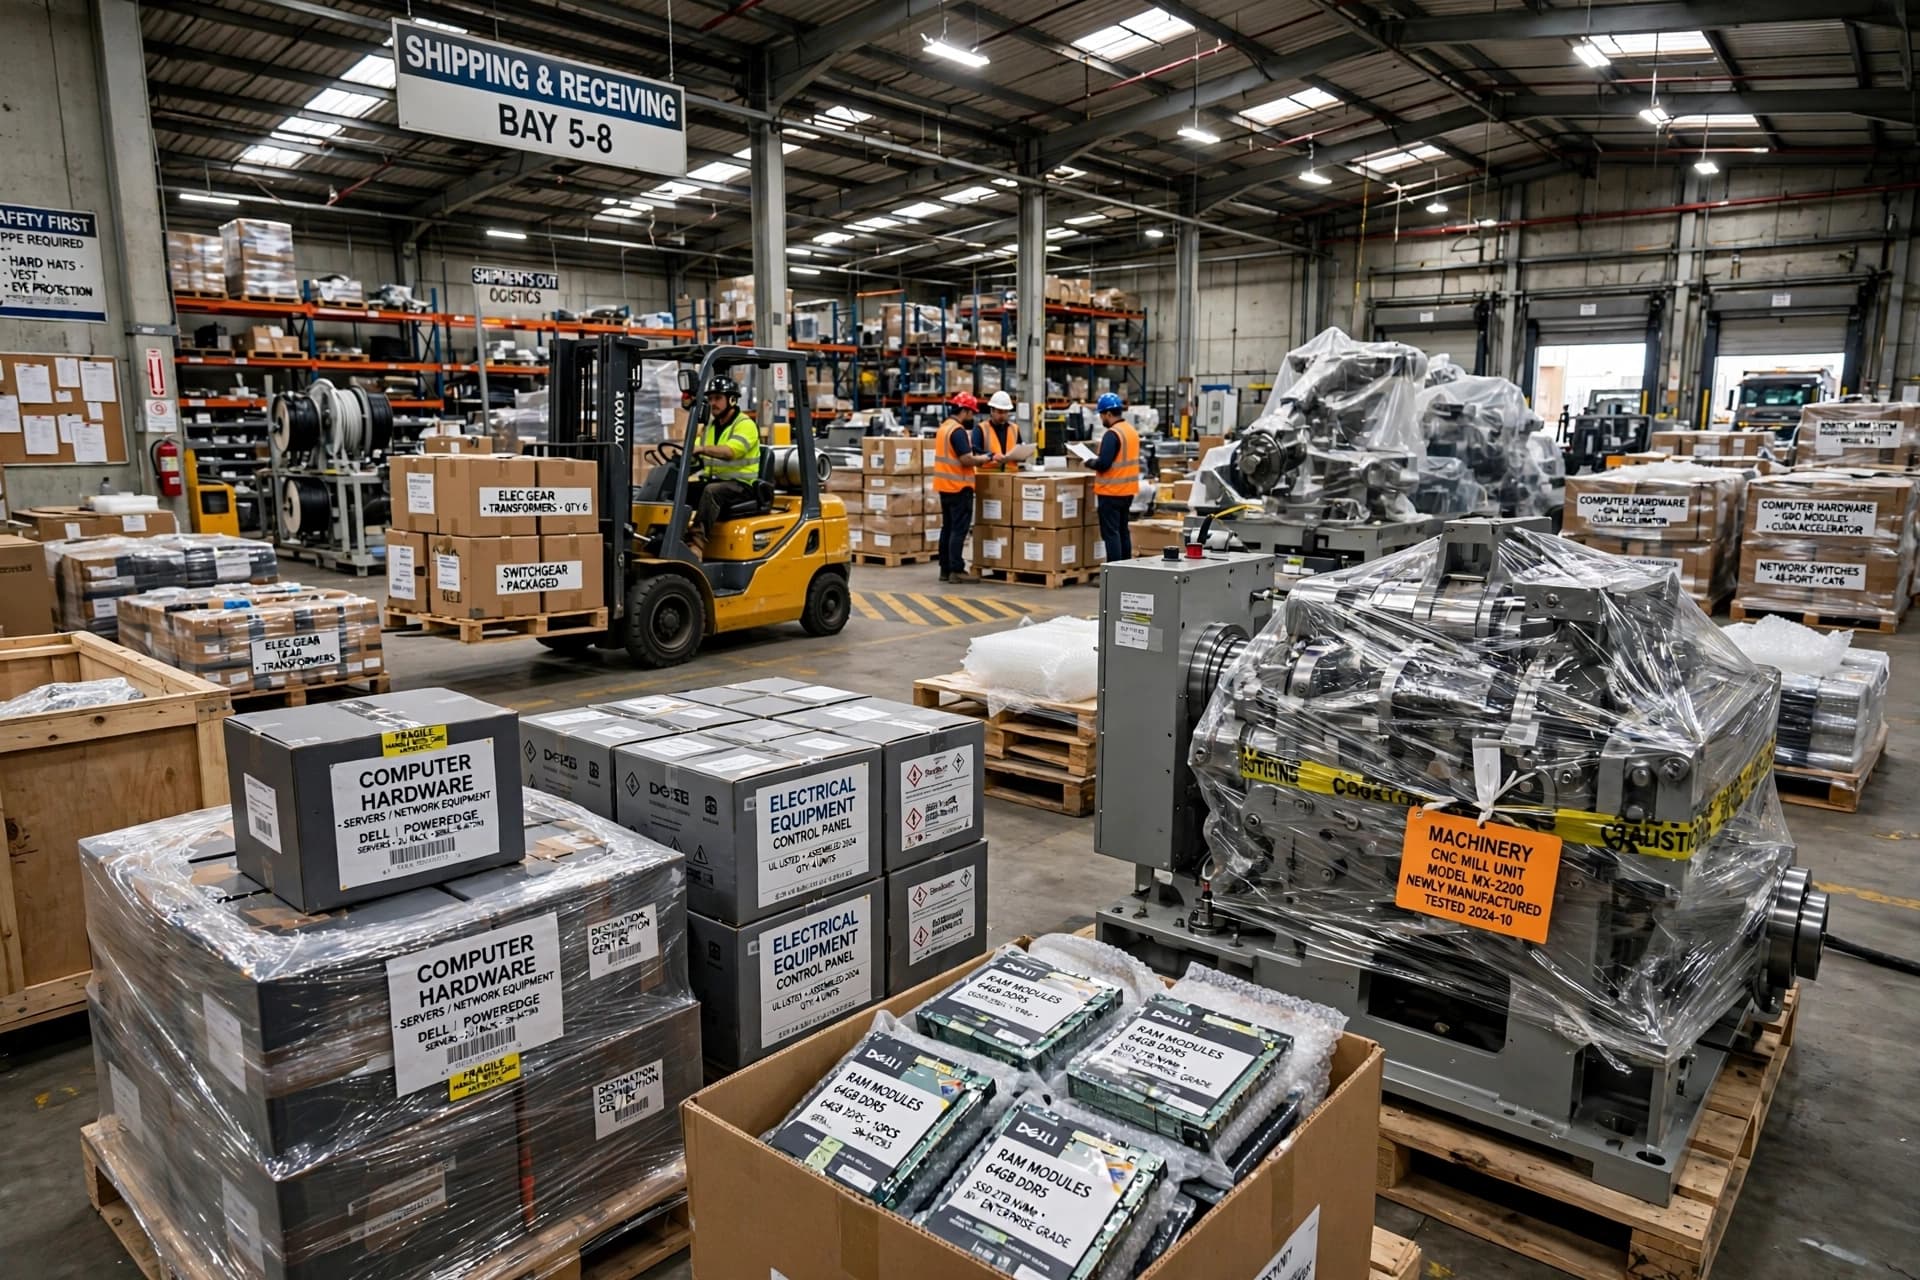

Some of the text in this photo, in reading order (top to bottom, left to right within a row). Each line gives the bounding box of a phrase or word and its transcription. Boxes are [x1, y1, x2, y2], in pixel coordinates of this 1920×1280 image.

[405, 34, 677, 122] SHIPPING & RECEIVING
[499, 103, 613, 154] BAY 5-8
[0, 209, 90, 232] AFETY FIRST
[0, 232, 84, 249] PPE REQUIRED
[9, 255, 76, 271] HARD HATS
[10, 268, 38, 281] VEST
[33, 282, 93, 297] PROTECTION
[536, 275, 557, 289] OUT
[489, 503, 588, 513] TRANSFORMERS QTY 6
[499, 490, 555, 501] ELEC GEAR
[1580, 496, 1686, 508] COMPUTER HARDWARE
[1761, 501, 1873, 514] COMPUTER HARDWARE
[1798, 523, 1864, 535] ACCELERATOR
[503, 564, 568, 579] SWITCHGEAR
[507, 578, 559, 592] PACKAGED
[1759, 562, 1860, 577] NETWORK SWITCHES
[1821, 576, 1845, 586] CAT6
[265, 639, 291, 651] ELEC
[359, 754, 471, 789] COMPUTER
[343, 812, 386, 829] SERVERS
[394, 802, 441, 818] NETWORK
[441, 790, 491, 809] EQUIPMENT
[361, 774, 474, 812] HARDWARE
[769, 776, 857, 813] ELECTRICAL
[359, 828, 390, 844] DELL
[404, 809, 479, 835] POWEREDGE
[770, 796, 856, 834] EQUIPMENT
[773, 817, 852, 850] CONTROL PANEL
[1429, 825, 1534, 863] MACHINERY
[768, 863, 778, 872] UL
[1427, 863, 1524, 897] MODEL MX-2200
[1431, 848, 1526, 881] CNC MILL UNIT
[1406, 874, 1542, 917] NEWLY MANUFACTURED
[1425, 893, 1513, 927] TESTED 2024-10
[773, 910, 859, 955] ELECTRICAL
[417, 934, 534, 984] COMPUTER
[773, 929, 859, 976] EQUIPMENT
[419, 956, 537, 1008] HARDWARE
[776, 951, 855, 991] CONTROL PANEL
[400, 1006, 445, 1030] SERVERS
[453, 988, 501, 1012] NETWORK
[502, 971, 555, 997] EQUIPMENT
[986, 975, 1013, 987] RAM
[1012, 983, 1063, 1005] MODULES
[418, 1024, 450, 1043] DELL
[464, 993, 541, 1028] POWEREDGE
[1128, 1034, 1188, 1058] 64GB DDR5
[1137, 1025, 1225, 1061] RAM MODULES
[463, 1058, 505, 1080] FRAGILE
[834, 1084, 887, 1113] 64GB DDR5
[845, 1072, 924, 1111] RAM MODULES
[985, 1163, 1050, 1199] 64GB DDR5
[997, 1149, 1093, 1199] RAM MODULES
[973, 1181, 993, 1194] SSD
[991, 1189, 1012, 1204] 2TB
[980, 1199, 1036, 1231] ENTERPRISE
[1036, 1225, 1072, 1249] GRADE
